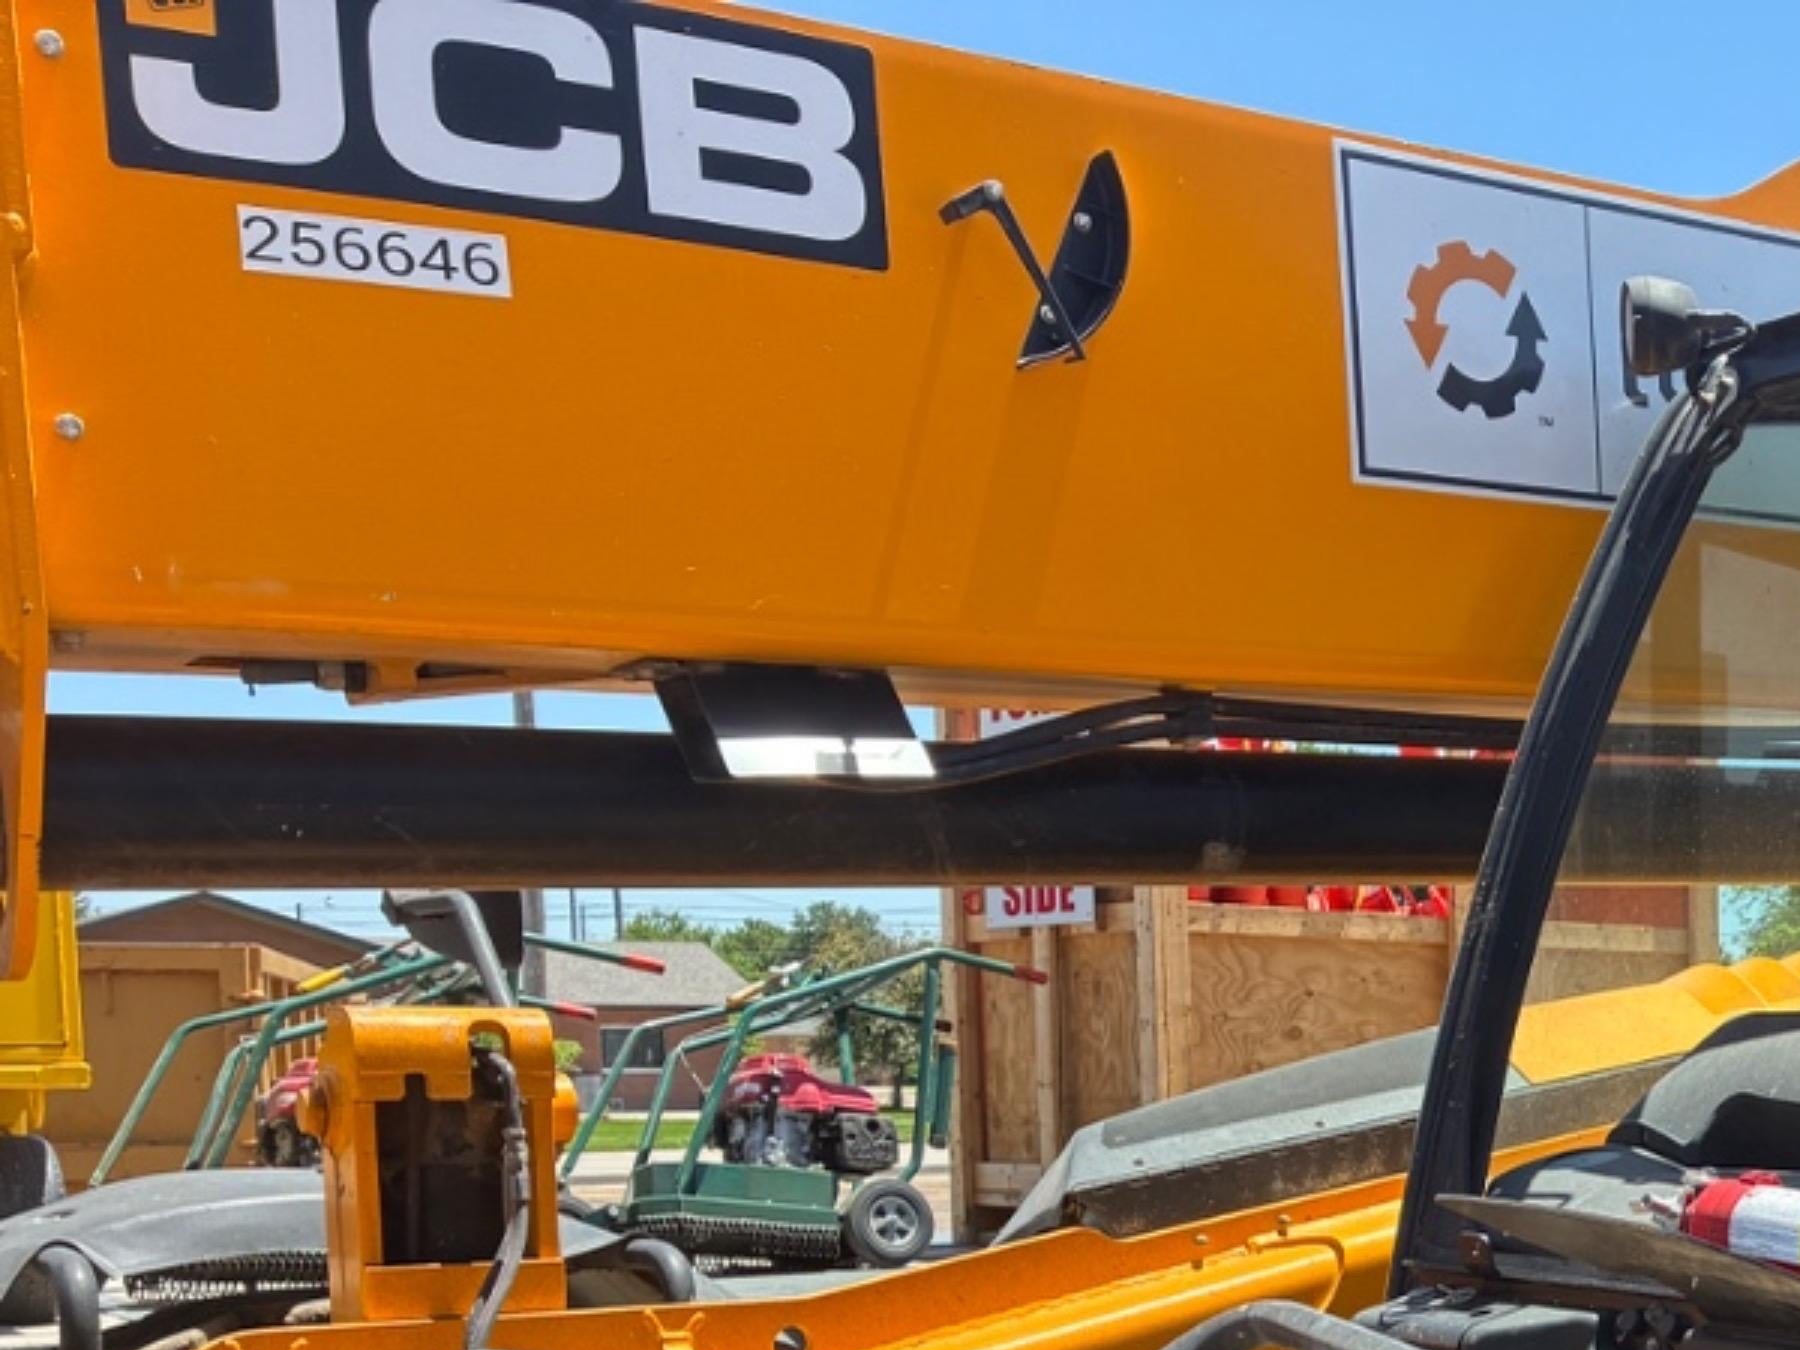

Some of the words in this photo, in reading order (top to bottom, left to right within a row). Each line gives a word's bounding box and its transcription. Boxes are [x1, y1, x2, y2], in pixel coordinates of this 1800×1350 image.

[130, 0, 866, 242] JCB
[241, 215, 501, 287] 256646
[1003, 885, 1075, 916] SIDE
